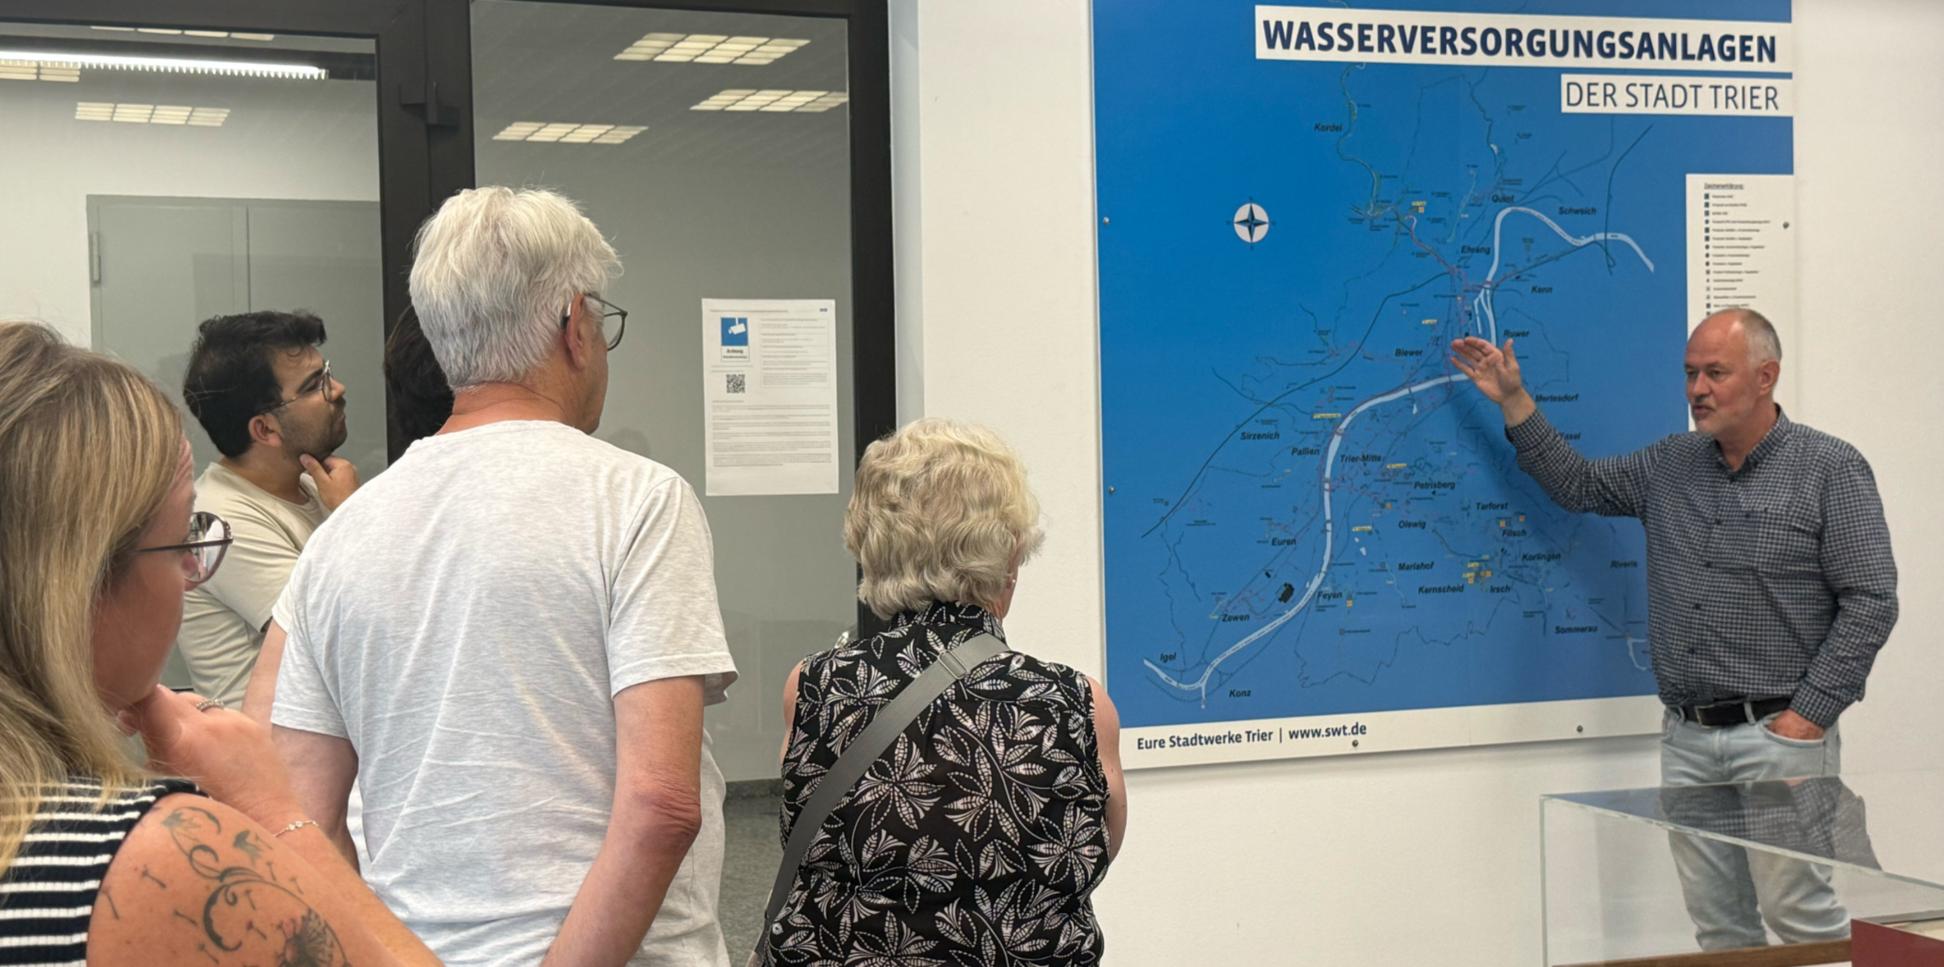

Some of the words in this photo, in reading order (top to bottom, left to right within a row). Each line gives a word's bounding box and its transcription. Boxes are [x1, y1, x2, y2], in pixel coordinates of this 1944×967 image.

[1262, 19, 1777, 63] WASSERVERSORGUNGSANLAGEN
[1566, 81, 1617, 107] DER
[1625, 83, 1703, 109] STADT
[1709, 84, 1779, 111] TRIER
[1313, 122, 1343, 133] Kordel
[1558, 205, 1597, 216] Schweich
[1461, 244, 1491, 255] Ehrang
[1531, 285, 1553, 294] Kenn
[1395, 347, 1424, 358] Biewer
[1240, 431, 1280, 441] Sirzenich
[1414, 480, 1456, 490] Petrisberg
[1476, 502, 1509, 511] Tarforst
[1398, 520, 1426, 530] Olewig
[1271, 537, 1297, 547] Euren
[1398, 562, 1434, 571] Mariahof
[1418, 584, 1464, 594] Kernscheid
[1317, 590, 1343, 600] Feyen
[1222, 613, 1250, 622] Zewen
[1554, 625, 1598, 634] Sommerau
[1160, 652, 1177, 662] Igel
[1229, 689, 1252, 698] Konz
[1137, 736, 1166, 750] Eure
[1169, 731, 1243, 748] Stadtwerke
[1246, 728, 1273, 743] Trier
[1288, 722, 1367, 740] www.swt.de
